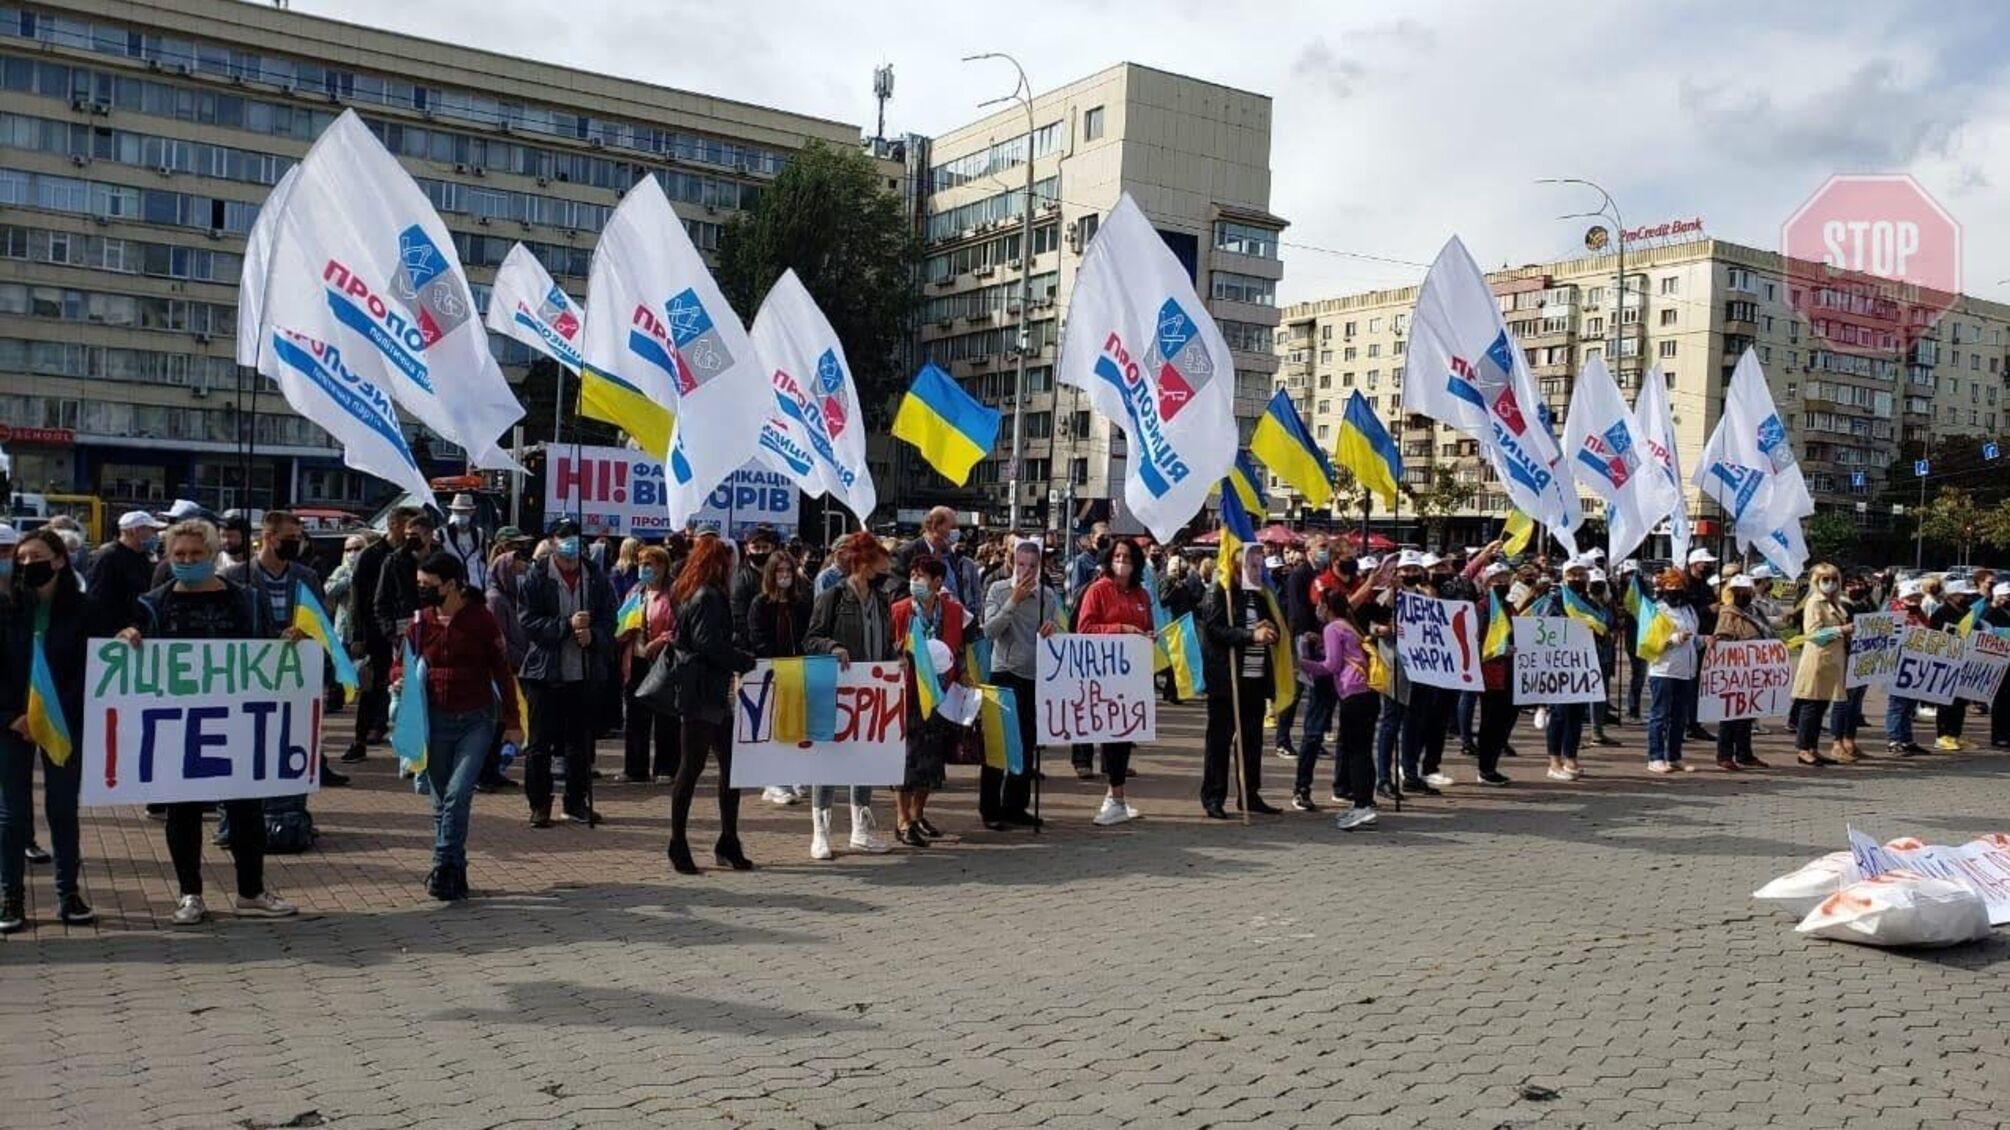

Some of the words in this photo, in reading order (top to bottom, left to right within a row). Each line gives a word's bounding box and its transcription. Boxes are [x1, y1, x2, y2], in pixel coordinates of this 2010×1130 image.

[1621, 226, 1670, 242] ProCredit
[1672, 216, 1704, 234] Bank
[1104, 331, 1190, 484] ПРОПОЗИЦІЯ
[556, 457, 628, 504] НІ!
[1422, 624, 1445, 647] НА
[95, 641, 304, 698] ЯЦЕНКА
[1045, 638, 1131, 681] УМАНЬ
[1408, 647, 1455, 673] НАРИ
[1518, 652, 1537, 669] ДЕ
[1545, 649, 1589, 669] ЧЕСНІ
[1071, 680, 1113, 707] ЗА
[1521, 668, 1600, 695] ВИБОРИ?
[1700, 666, 1790, 698] НЕЗАЛЕЖНУ
[1895, 657, 1961, 698] БУТИ
[1045, 694, 1147, 741] ЦЕБРІЯ
